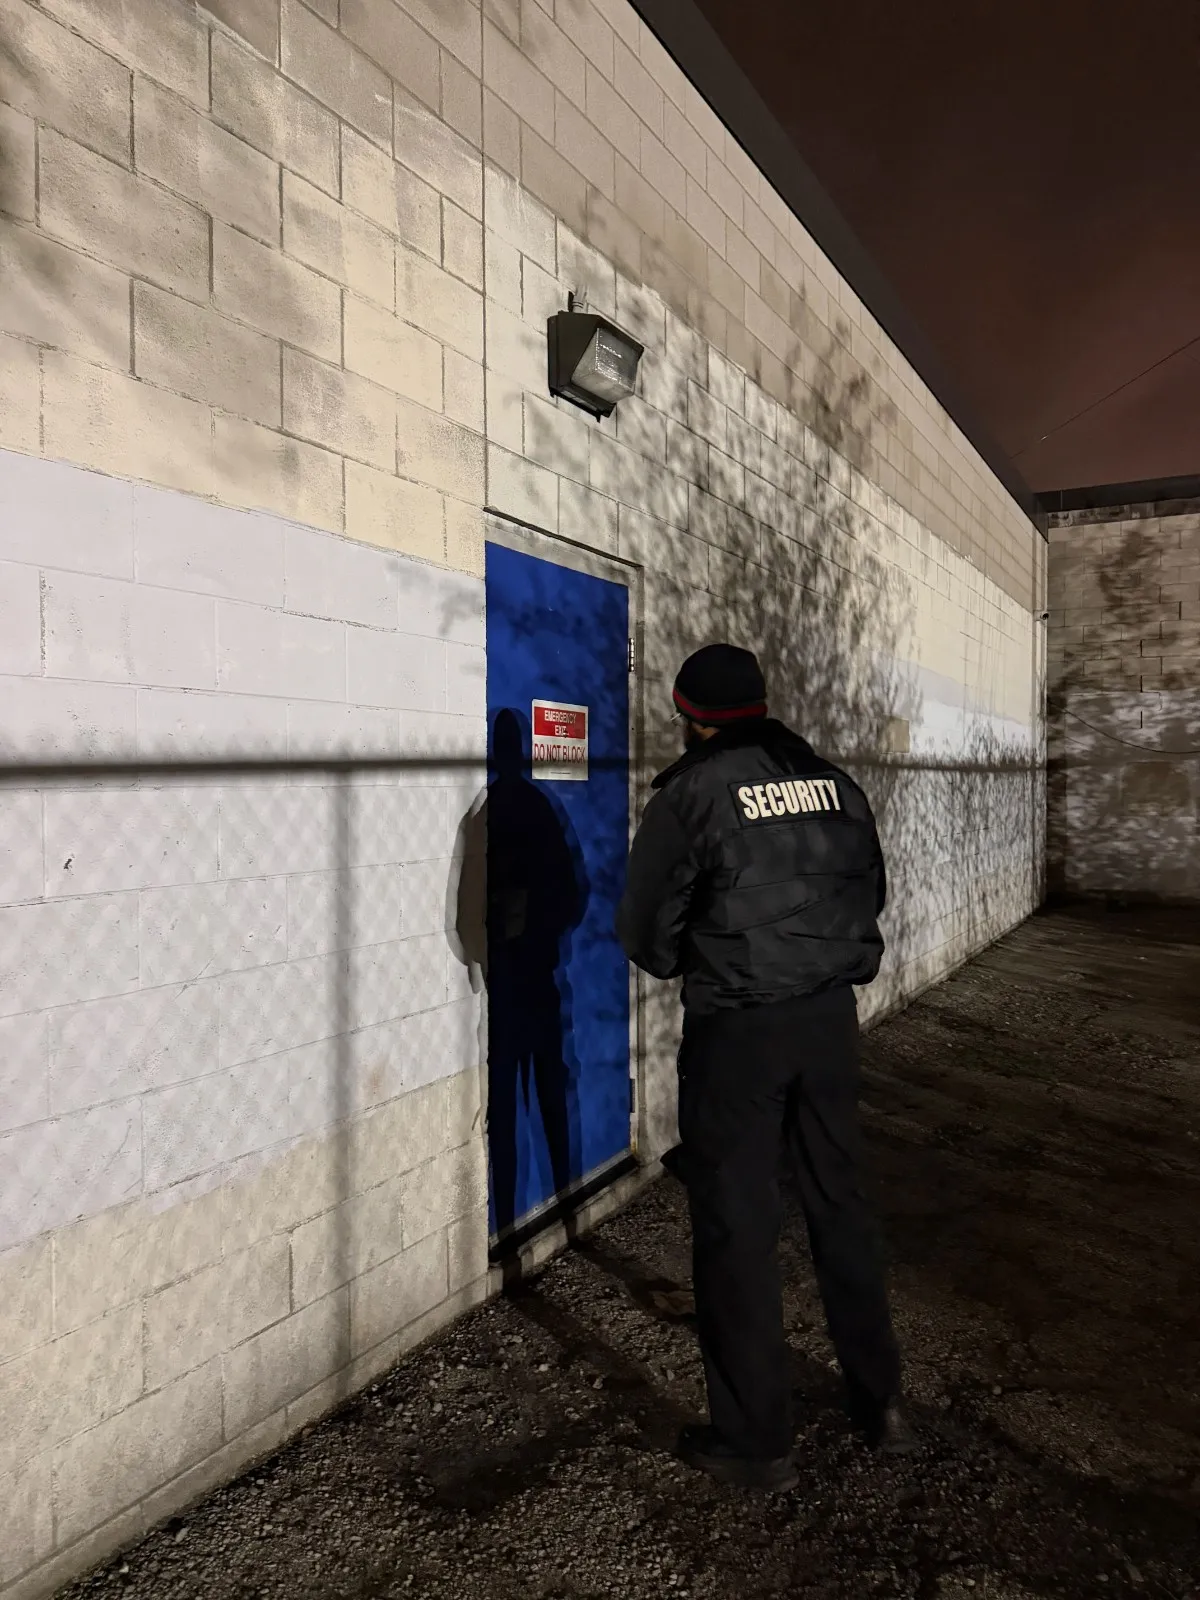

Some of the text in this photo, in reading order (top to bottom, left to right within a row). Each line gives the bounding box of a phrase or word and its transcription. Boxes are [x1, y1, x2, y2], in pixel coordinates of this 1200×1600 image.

[544, 709, 577, 724] EMERGENCY
[534, 743, 586, 764] DO NOT BLOCK
[738, 779, 841, 820] SECURITY
